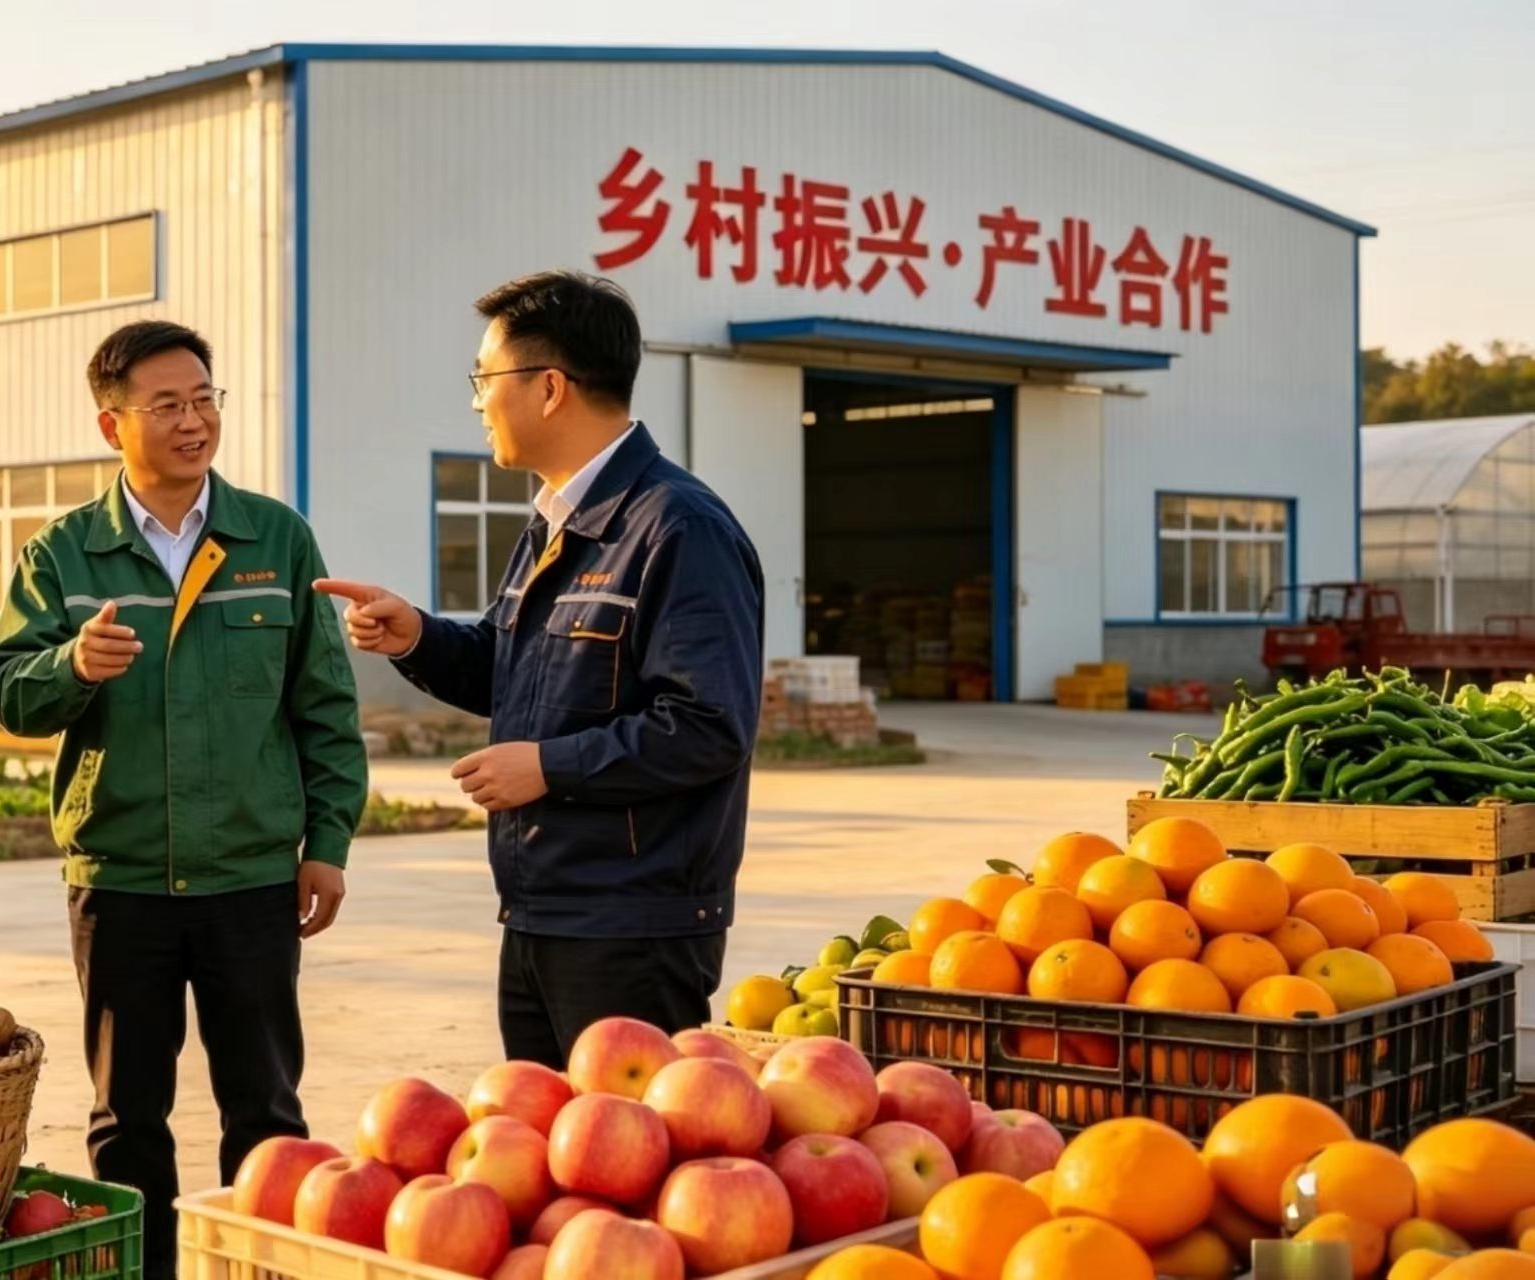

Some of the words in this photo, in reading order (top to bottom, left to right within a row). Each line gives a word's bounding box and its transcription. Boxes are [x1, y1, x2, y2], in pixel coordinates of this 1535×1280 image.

[593, 147, 1230, 334] 乡村振兴·产业合作
